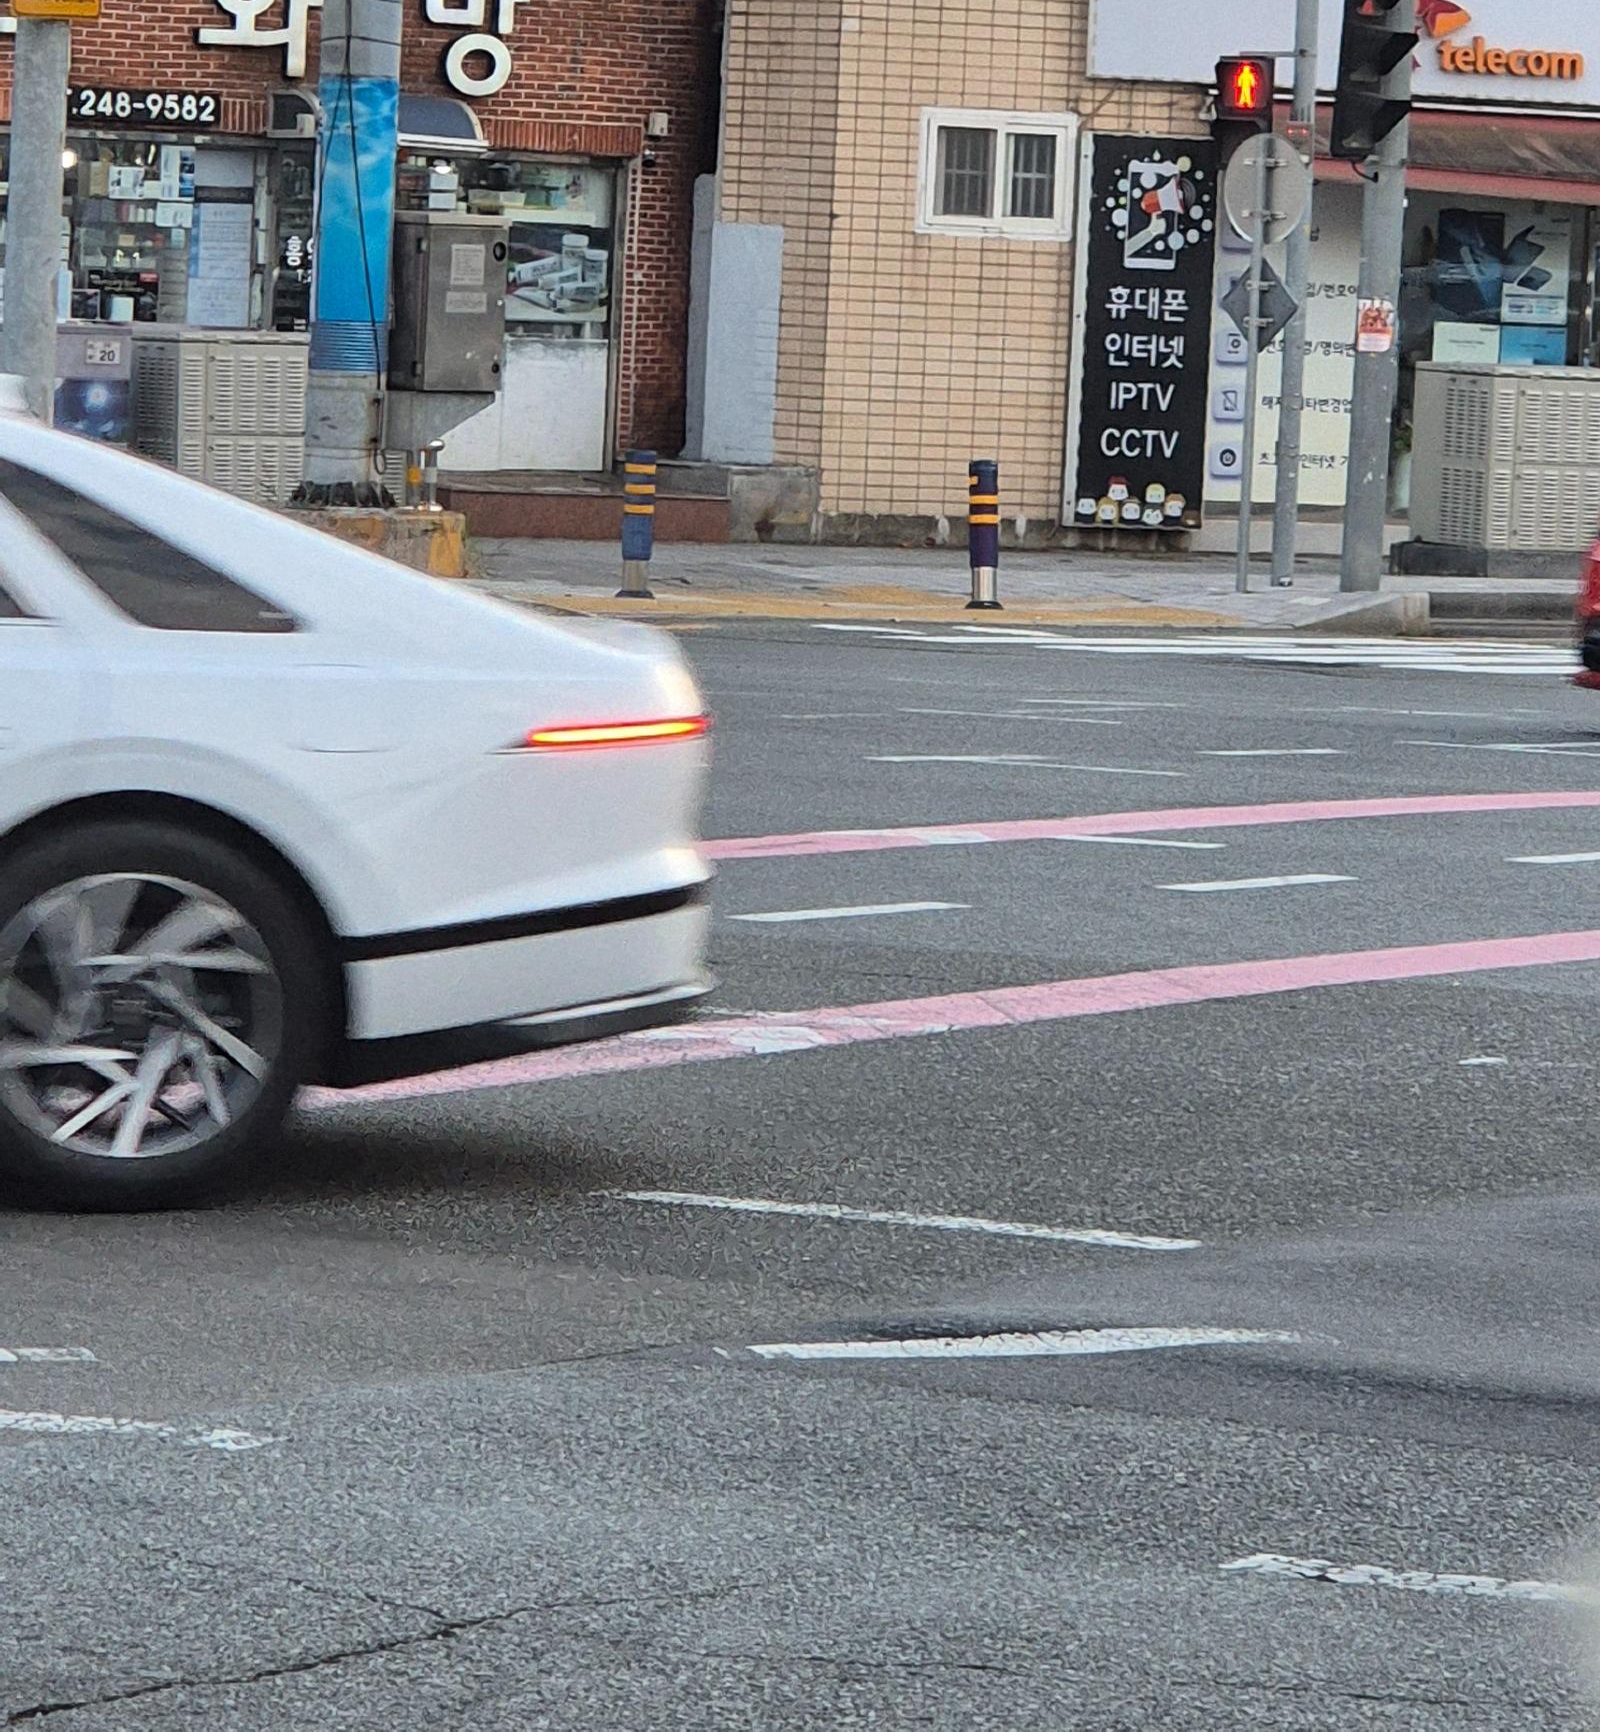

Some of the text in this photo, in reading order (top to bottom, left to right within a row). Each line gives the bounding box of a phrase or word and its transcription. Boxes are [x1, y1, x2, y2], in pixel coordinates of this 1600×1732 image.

[1437, 35, 1584, 82] telecom
[1105, 285, 1190, 323] 휴대폰
[1104, 332, 1185, 369] 인터넷
[1110, 381, 1175, 412] IPTV
[1100, 427, 1180, 459] CCTV
